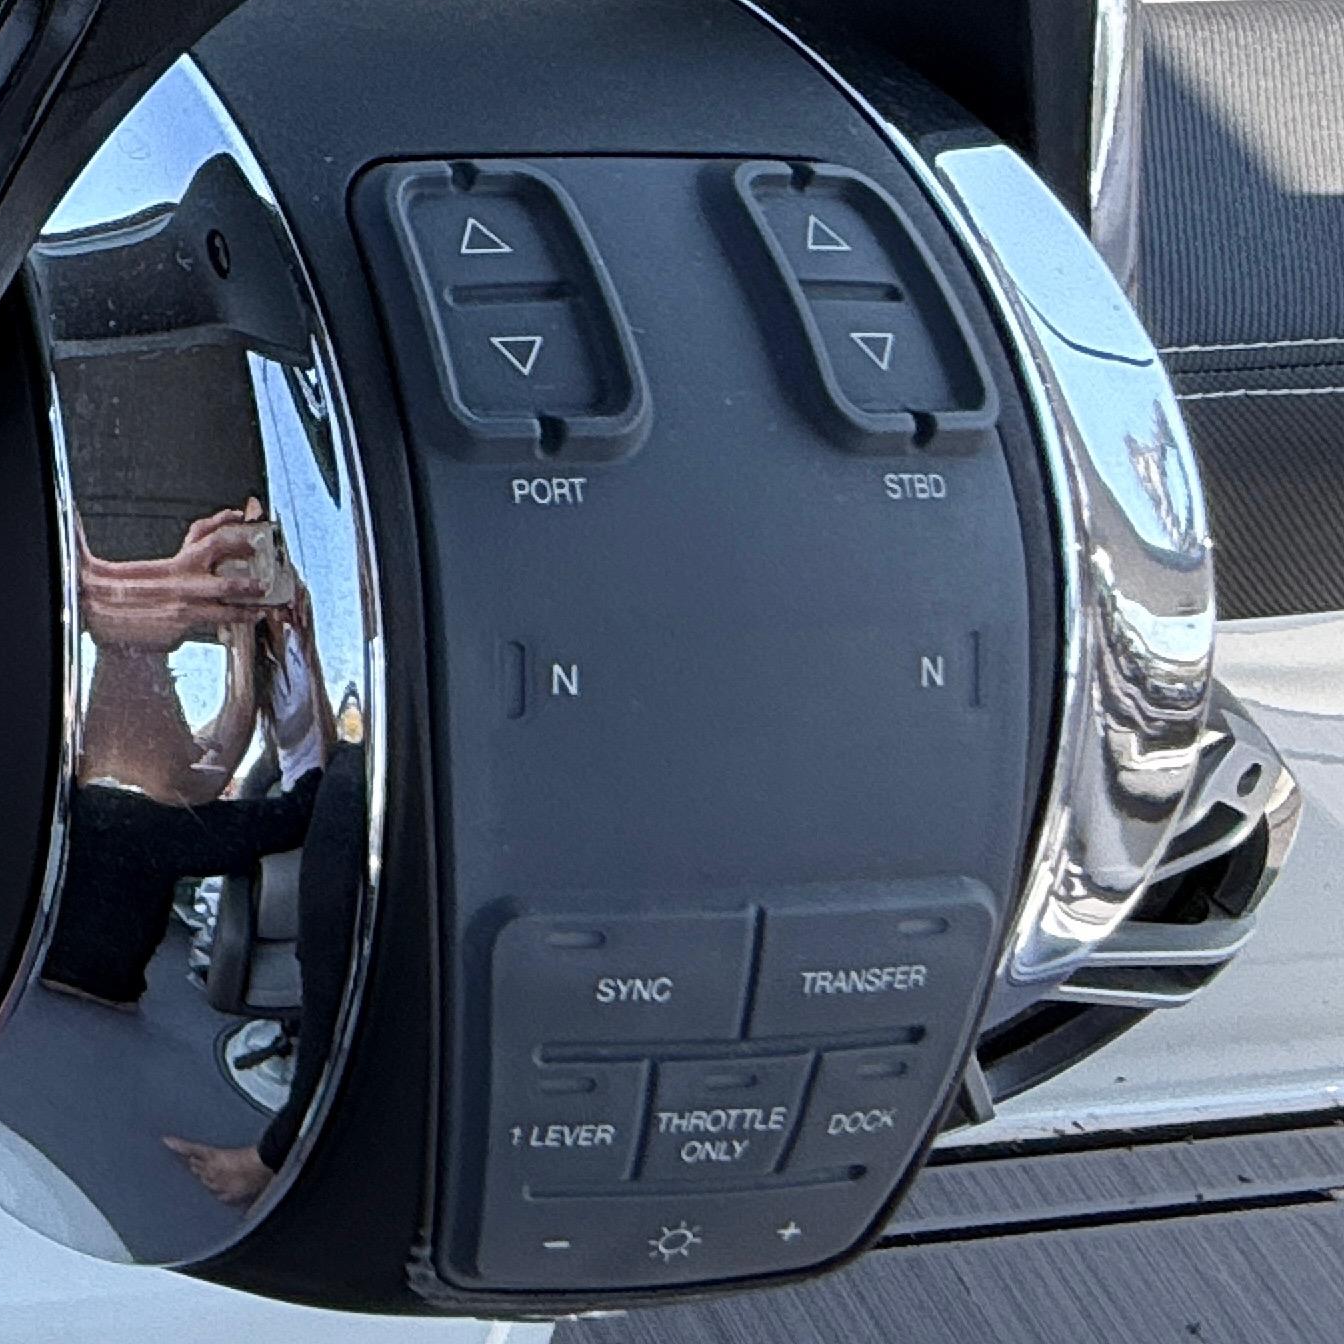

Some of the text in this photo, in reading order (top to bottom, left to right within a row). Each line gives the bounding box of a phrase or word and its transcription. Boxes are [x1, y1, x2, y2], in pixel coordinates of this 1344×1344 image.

[512, 476, 587, 505] PORT
[884, 474, 946, 500] STBD
[552, 663, 579, 696] N
[921, 657, 944, 687] N
[596, 977, 673, 1003] SYNC
[801, 964, 927, 995] TRANSFER
[657, 1106, 789, 1134] THROTTLE
[826, 1109, 896, 1135] DOCK
[529, 1124, 616, 1147] LEVER
[679, 1139, 749, 1163] ONLY
